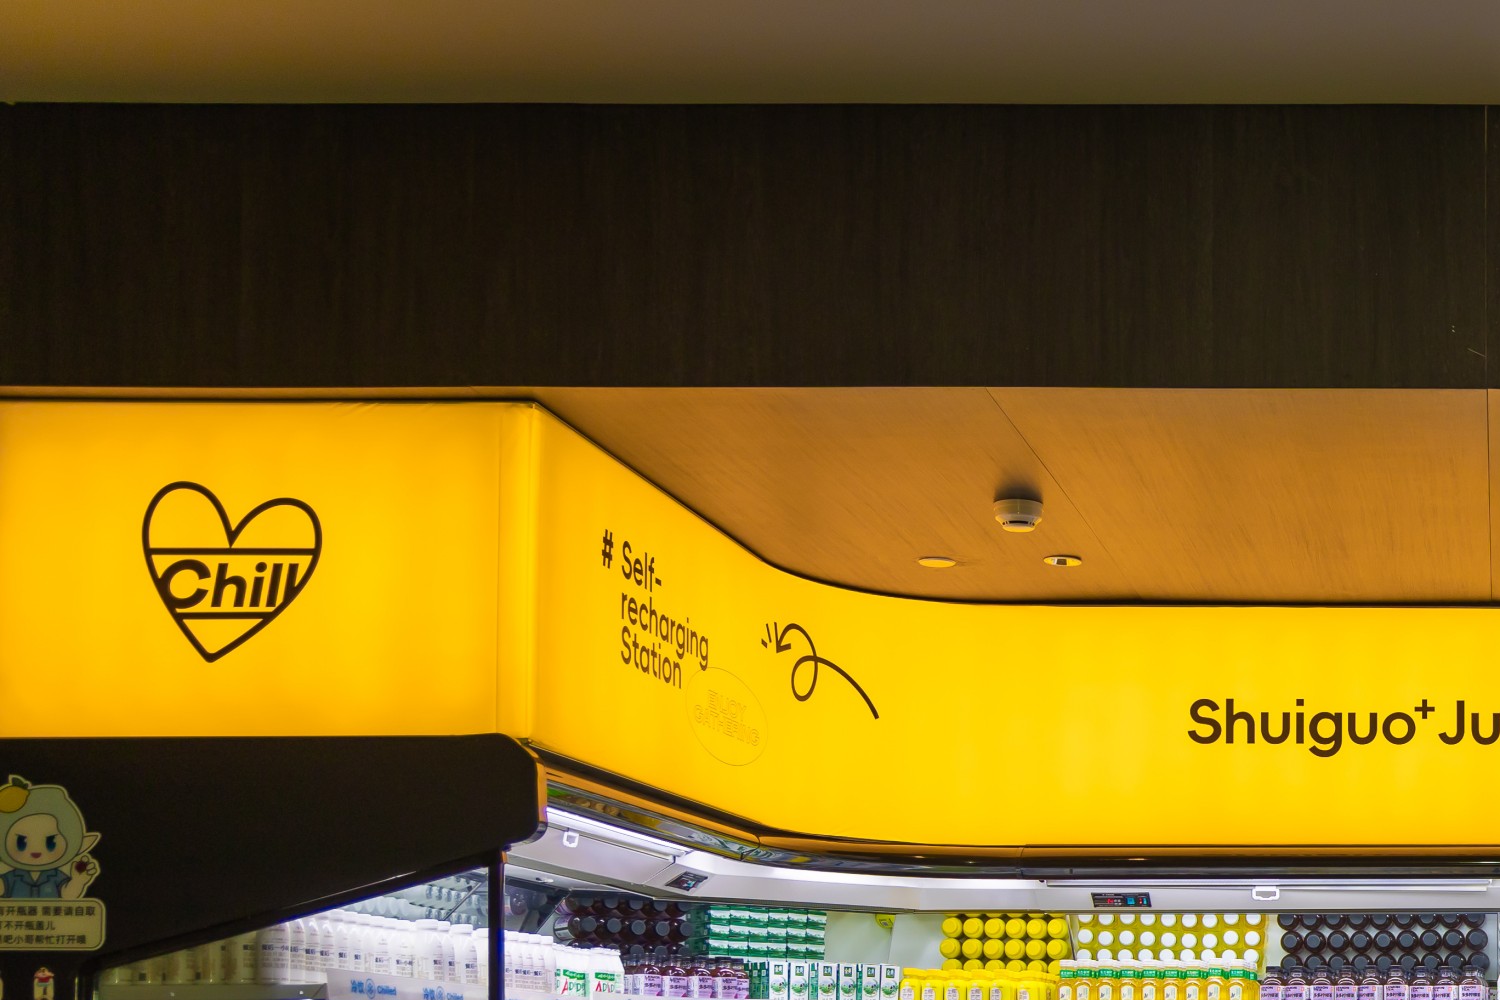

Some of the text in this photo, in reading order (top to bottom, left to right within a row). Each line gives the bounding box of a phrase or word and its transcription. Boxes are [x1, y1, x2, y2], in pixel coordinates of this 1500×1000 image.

[158, 559, 300, 610] Chill
[621, 541, 663, 593] Self-
[621, 592, 709, 671] recharging
[620, 626, 682, 689] Station
[0, 920, 55, 931] 不开瓶盖儿
[0, 934, 87, 945] 吧小哥帮忙打开哦
